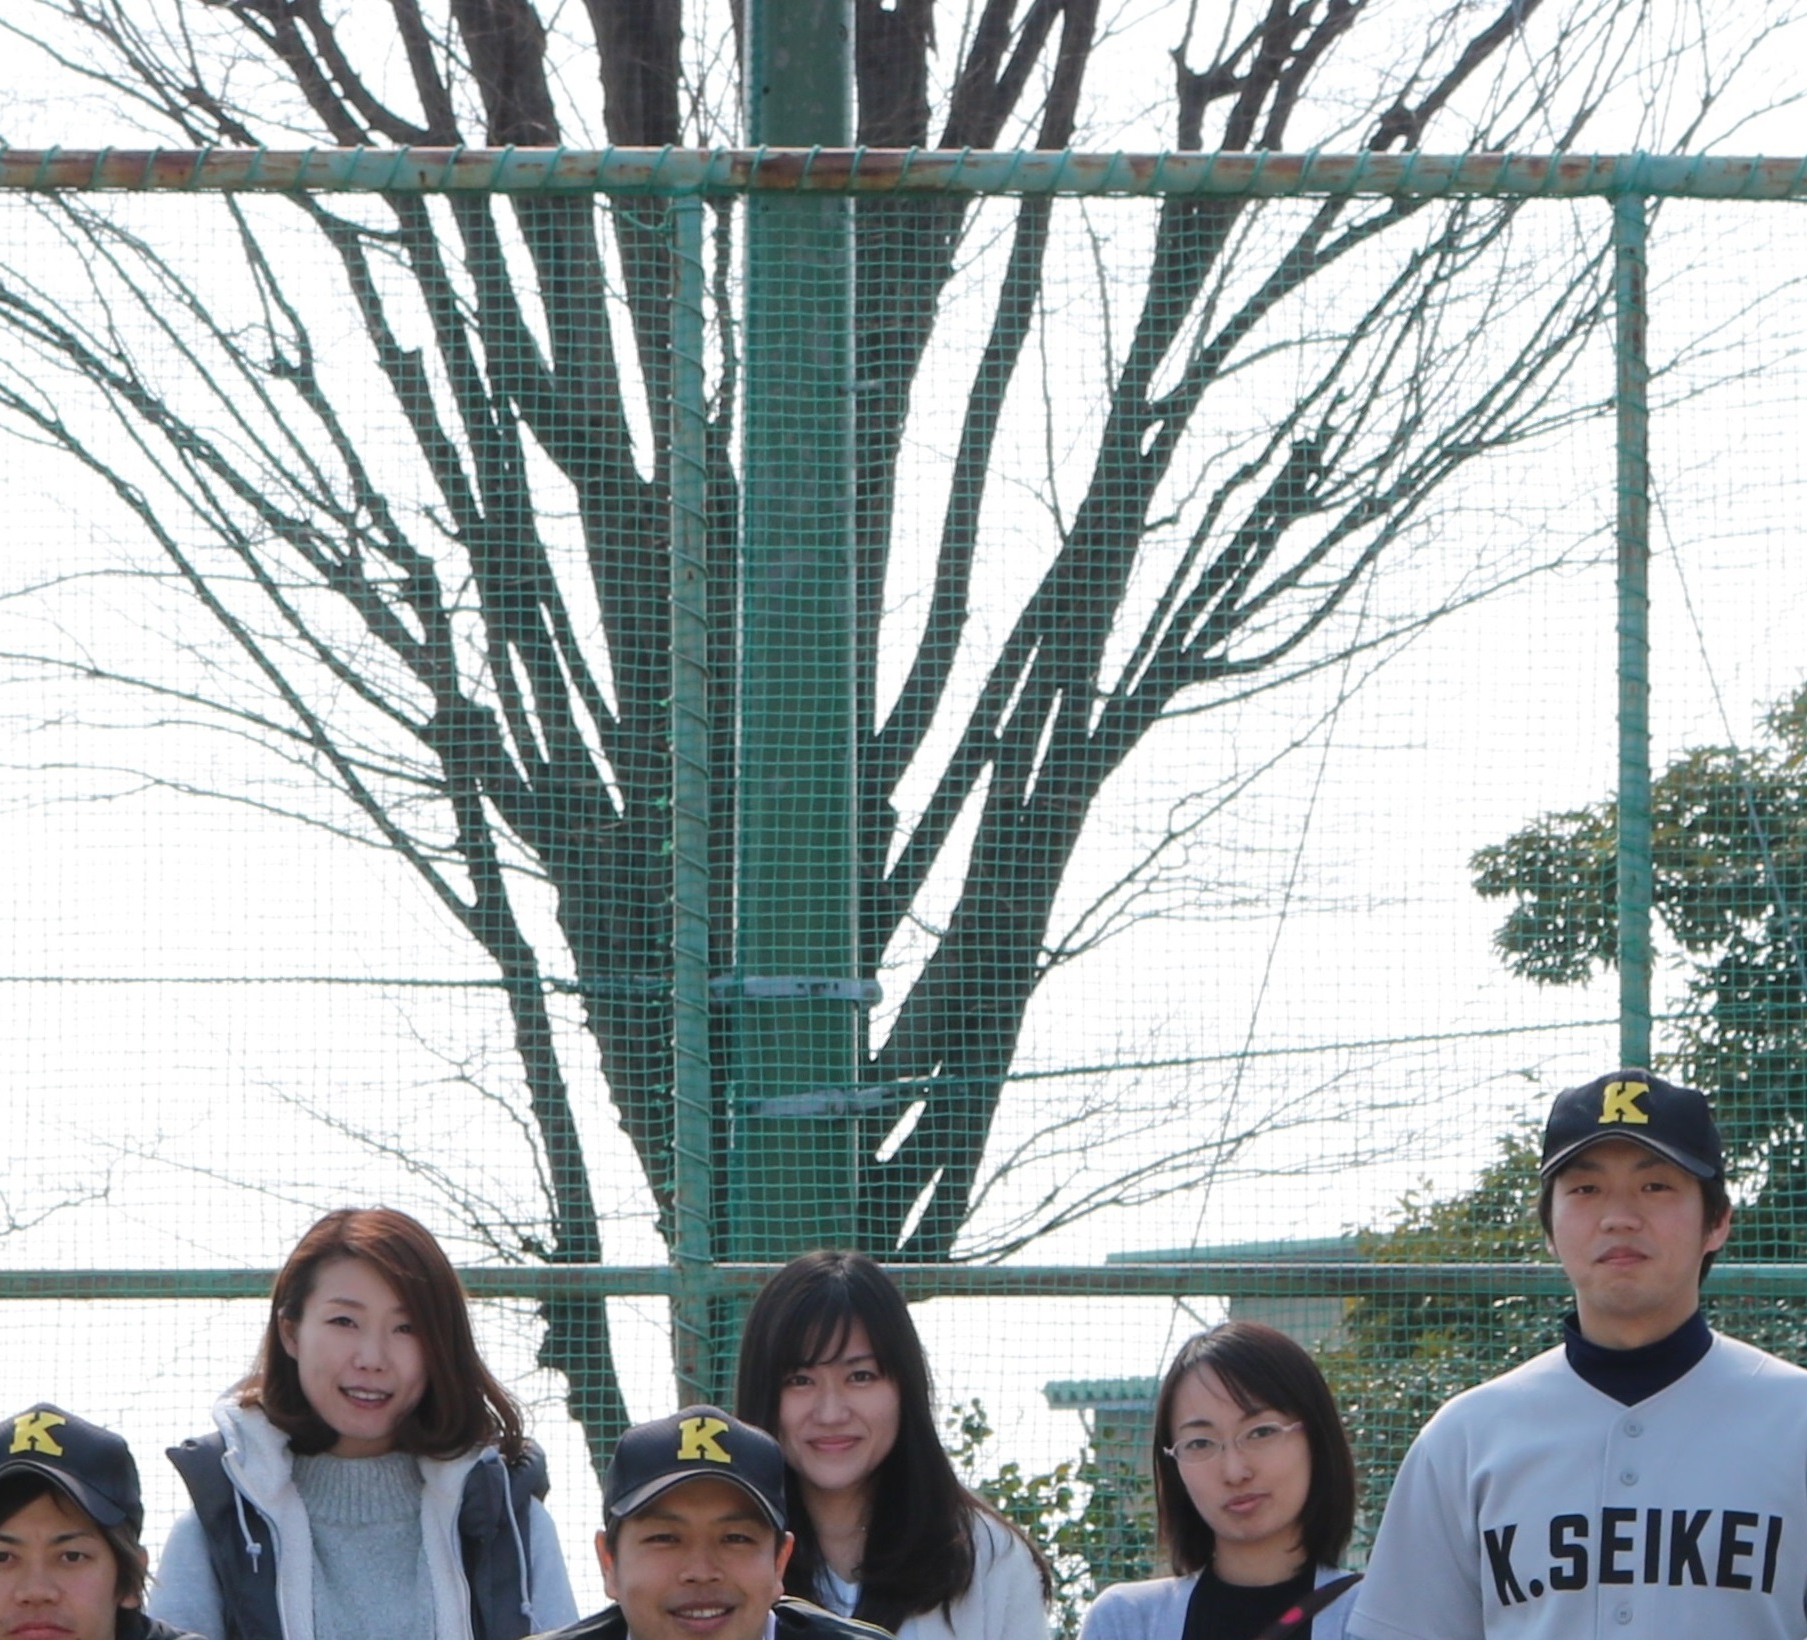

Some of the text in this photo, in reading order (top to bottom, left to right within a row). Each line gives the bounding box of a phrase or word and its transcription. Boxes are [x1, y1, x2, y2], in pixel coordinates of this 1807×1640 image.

[1598, 1081, 1650, 1124] K
[10, 1412, 66, 1456] K
[677, 1417, 731, 1464] K
[1483, 1506, 1784, 1606] K.SEIKEI
